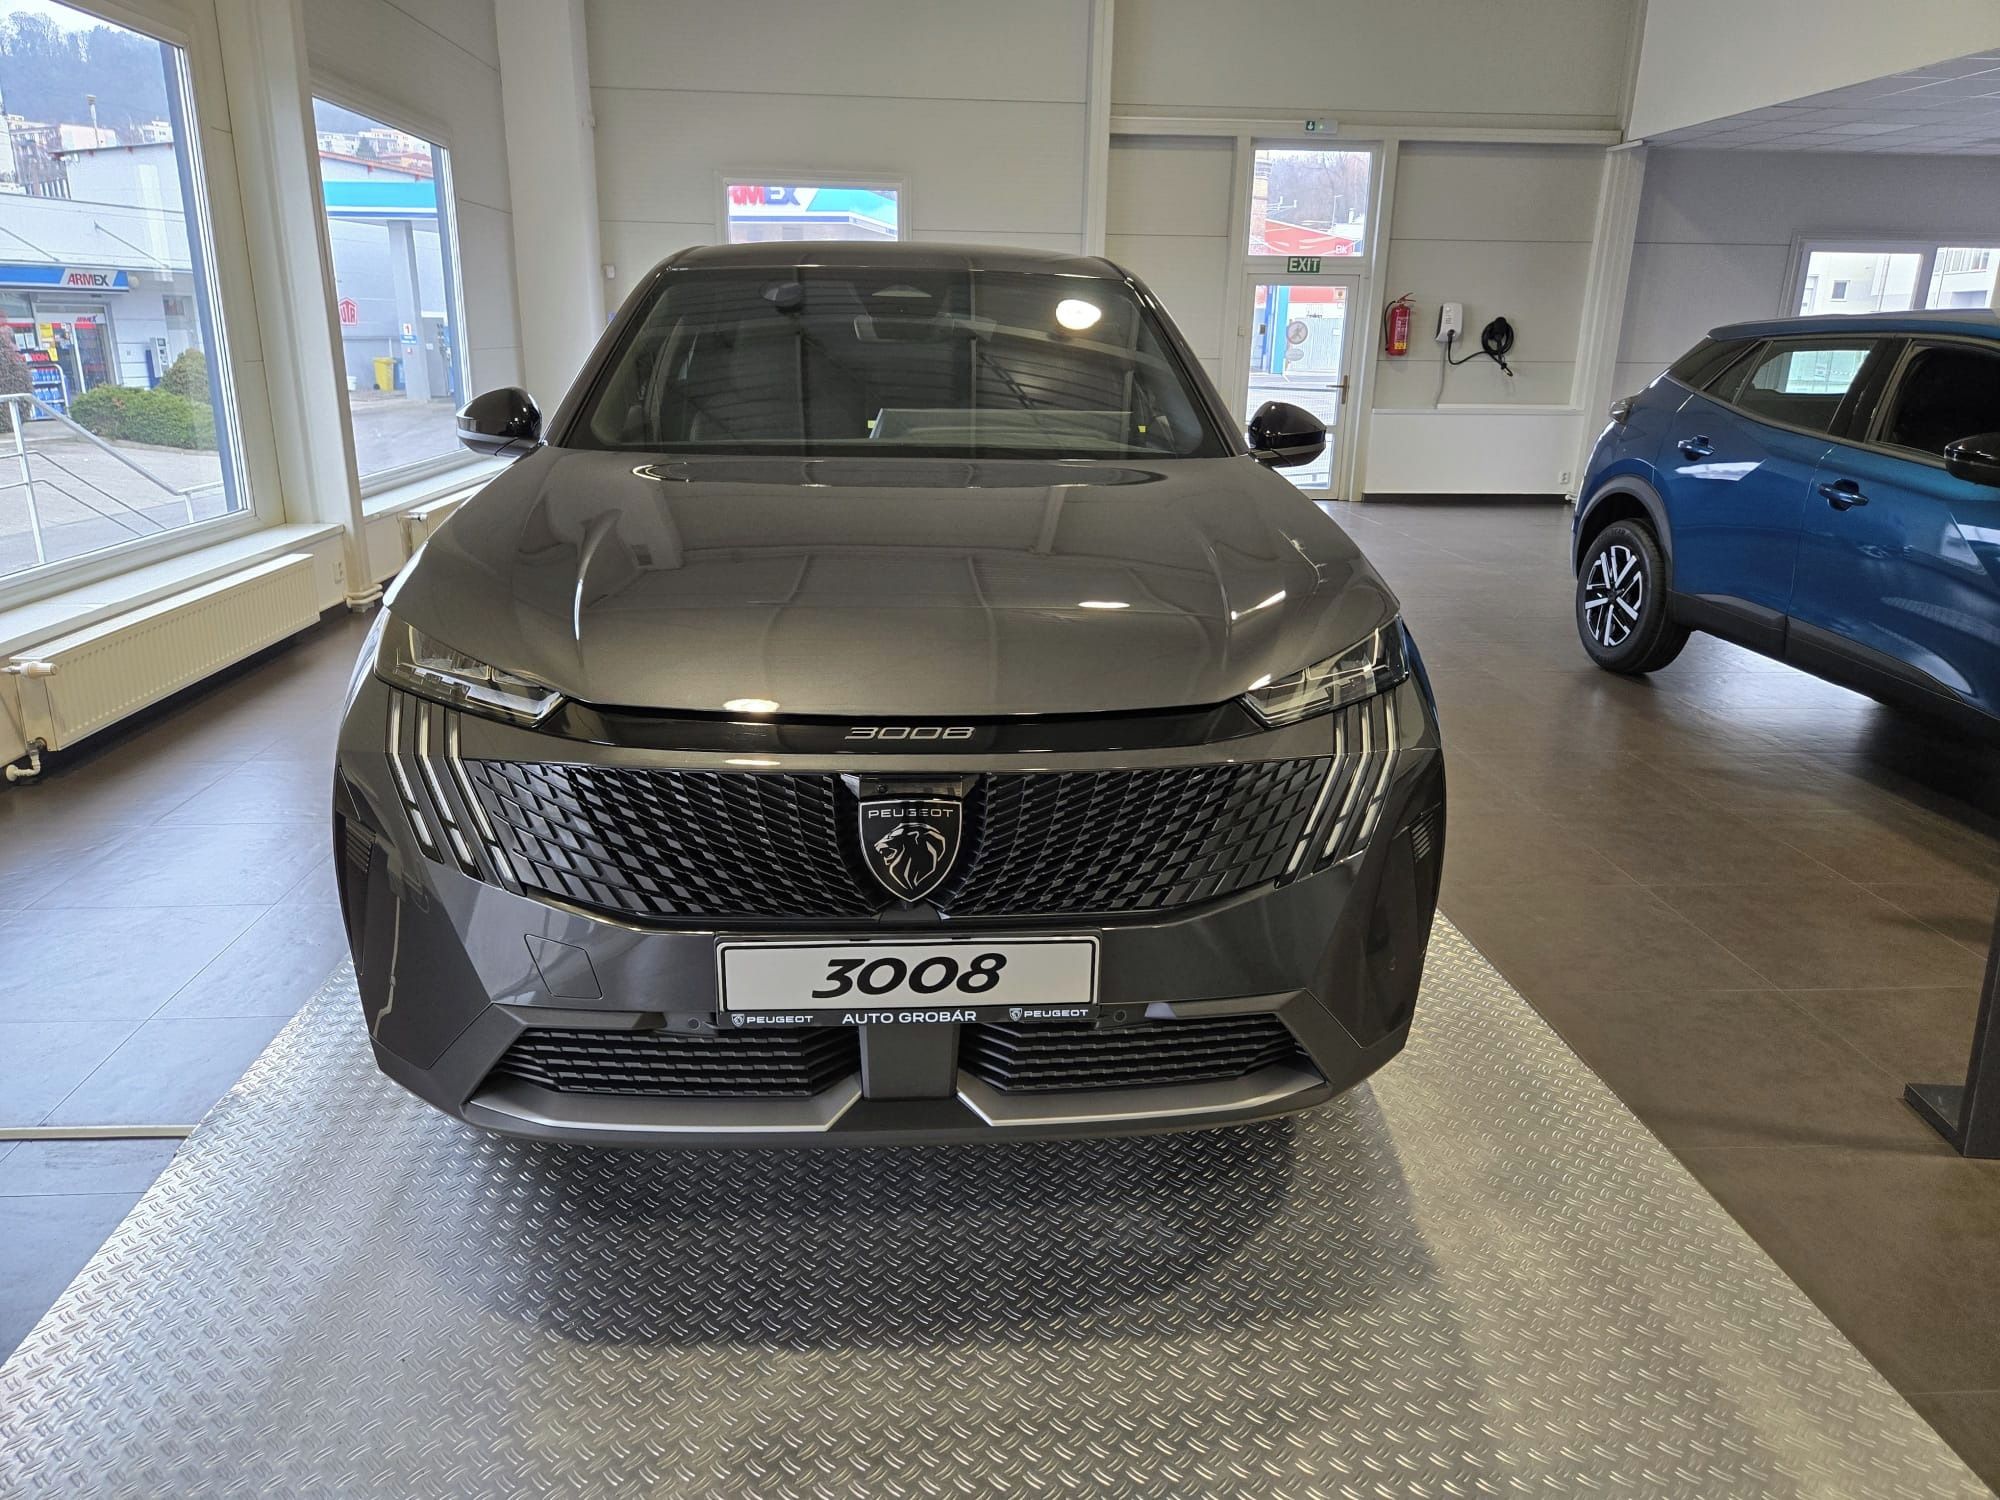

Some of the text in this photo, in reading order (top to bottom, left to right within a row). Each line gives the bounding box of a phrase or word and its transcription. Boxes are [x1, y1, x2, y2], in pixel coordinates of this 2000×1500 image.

[1288, 258, 1319, 271] EXIT
[67, 273, 109, 287] ARMEX
[845, 726, 976, 740] 3008
[868, 808, 954, 818] PEUGEOT
[811, 952, 1008, 999] 3008
[746, 1015, 814, 1024] PEUGEOT
[842, 1009, 977, 1024] AUTO GROBÁR
[1024, 1009, 1089, 1018] PEUGEOT
